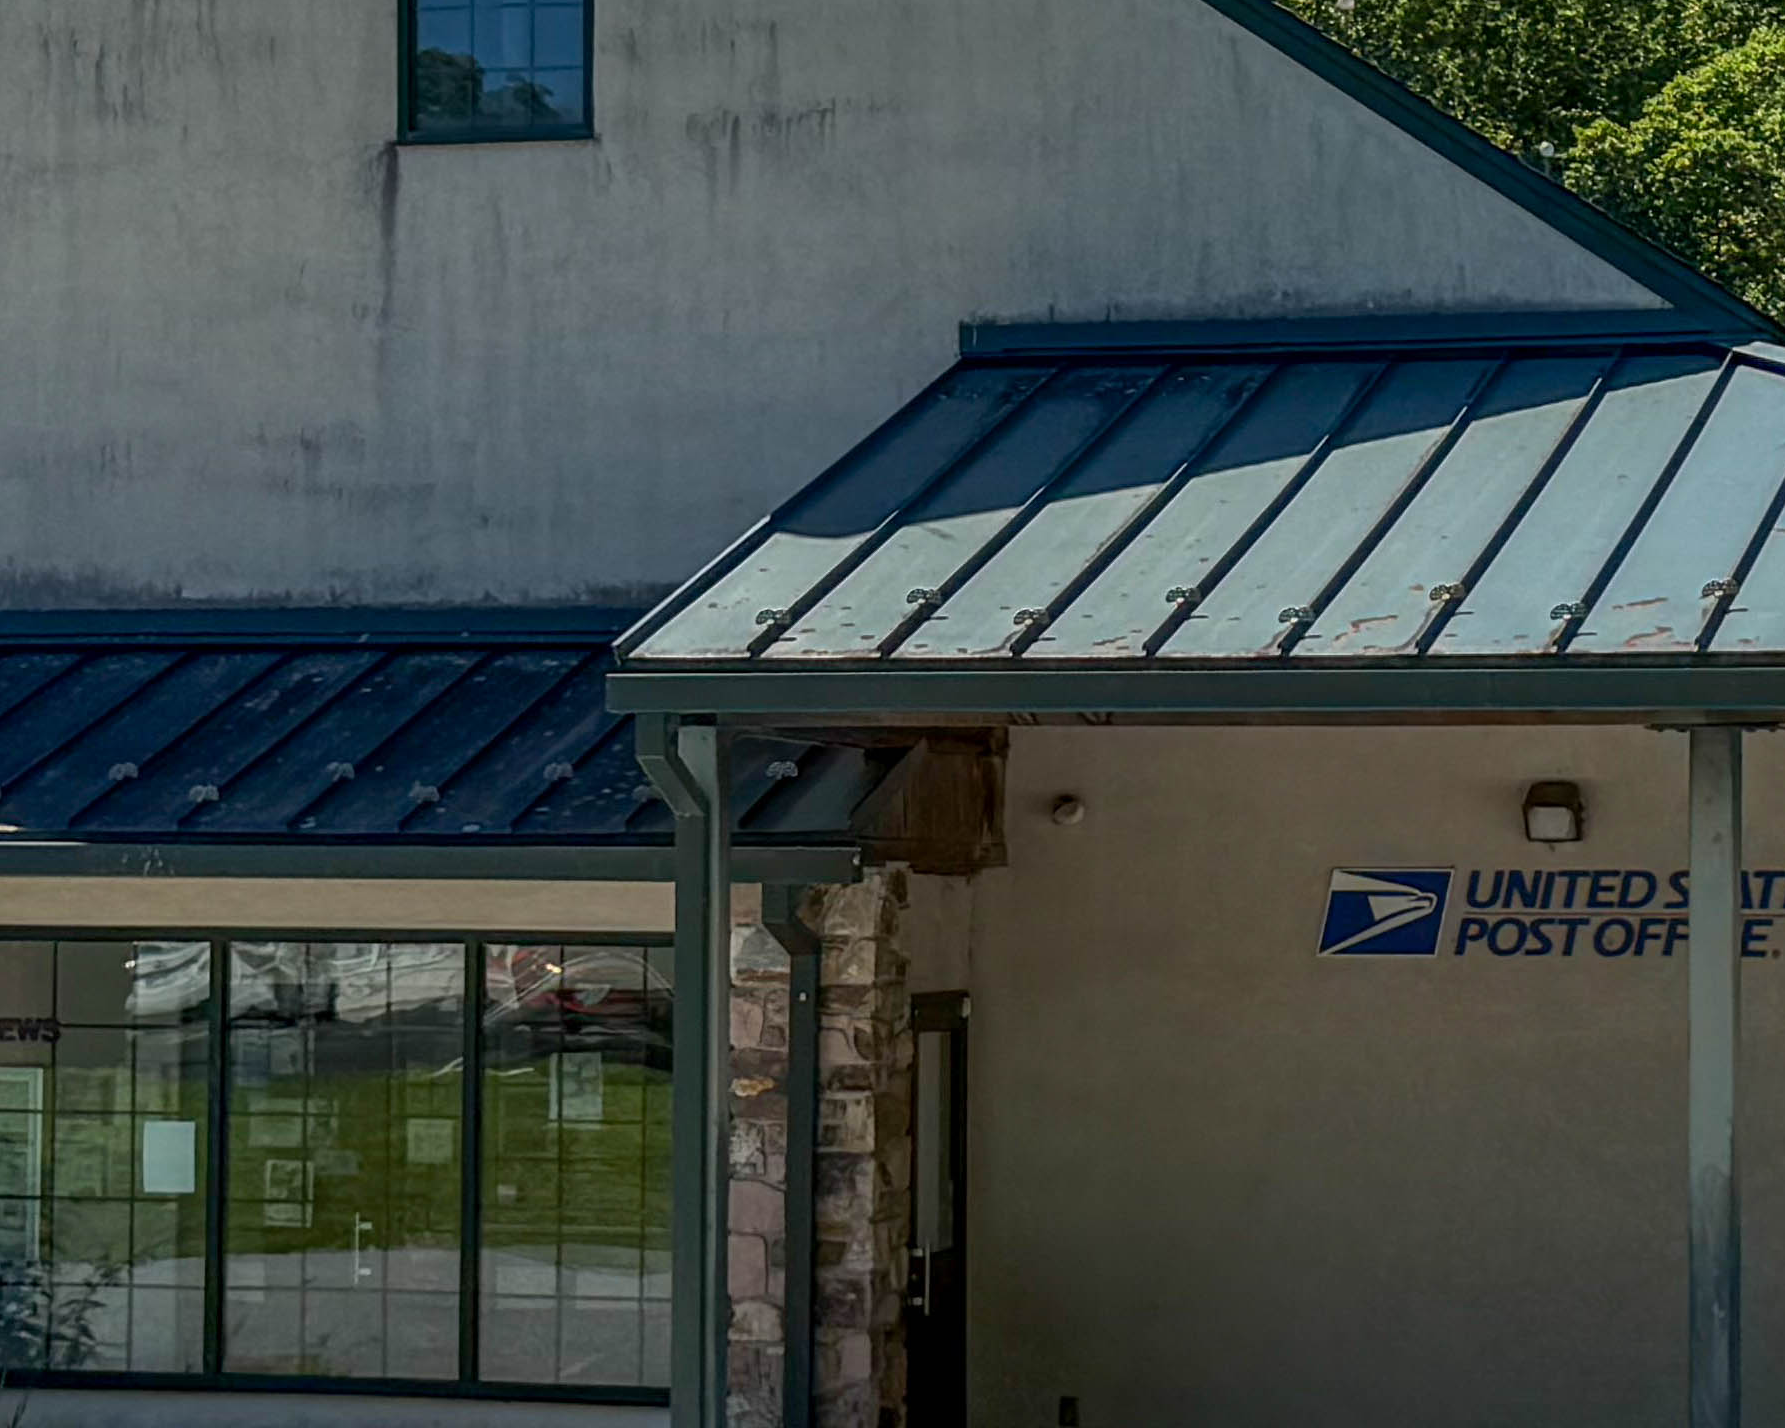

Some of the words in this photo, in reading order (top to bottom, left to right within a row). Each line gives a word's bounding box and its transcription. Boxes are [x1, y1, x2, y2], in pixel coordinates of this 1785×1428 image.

[1465, 870, 1657, 910] UNITED
[1454, 918, 1590, 958] POST
[1592, 918, 1774, 958] OFFE
